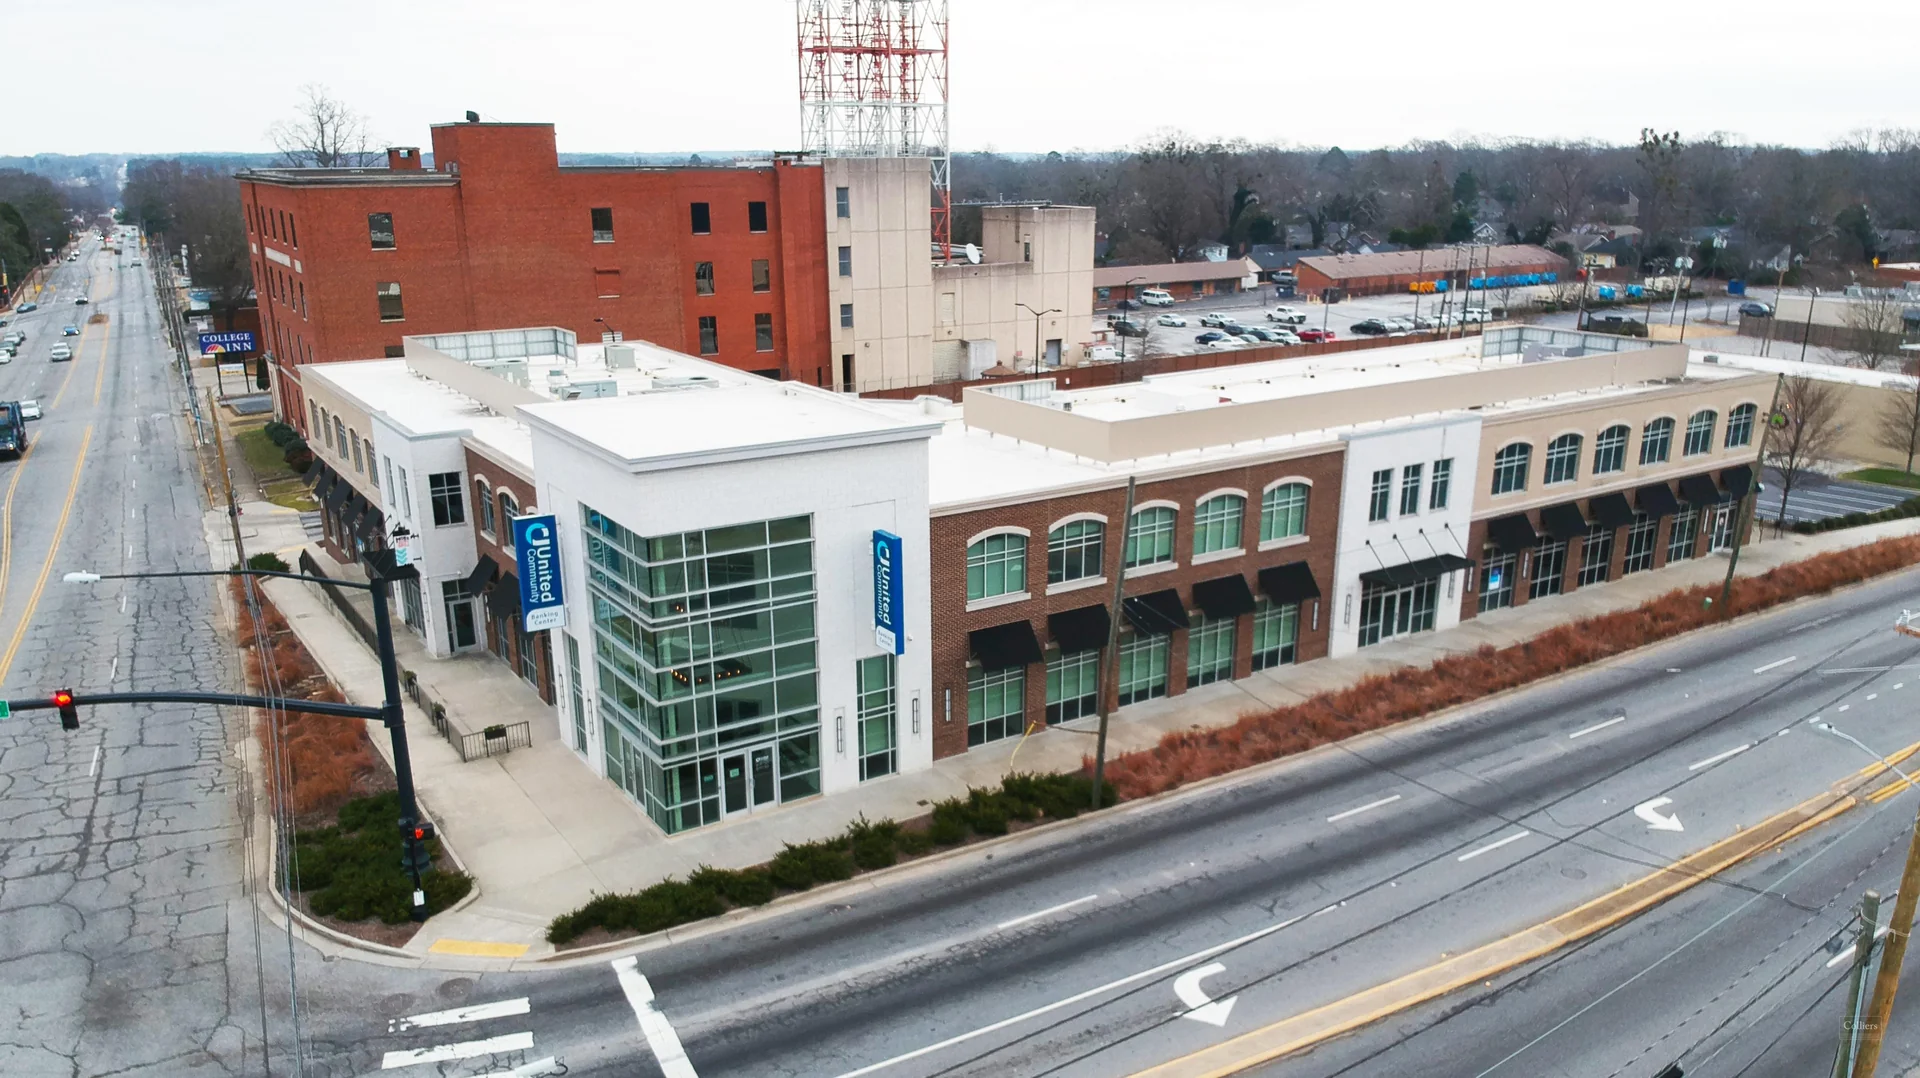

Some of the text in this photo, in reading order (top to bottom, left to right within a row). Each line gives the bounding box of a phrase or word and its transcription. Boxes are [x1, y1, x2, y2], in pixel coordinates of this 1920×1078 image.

[202, 333, 251, 343] COLLEGE
[226, 342, 252, 352] INN
[527, 549, 539, 604] Community
[537, 547, 556, 603] United
[876, 564, 884, 621] Community
[881, 565, 892, 625] United
[531, 611, 559, 620] Banking
[534, 618, 557, 626] Center
